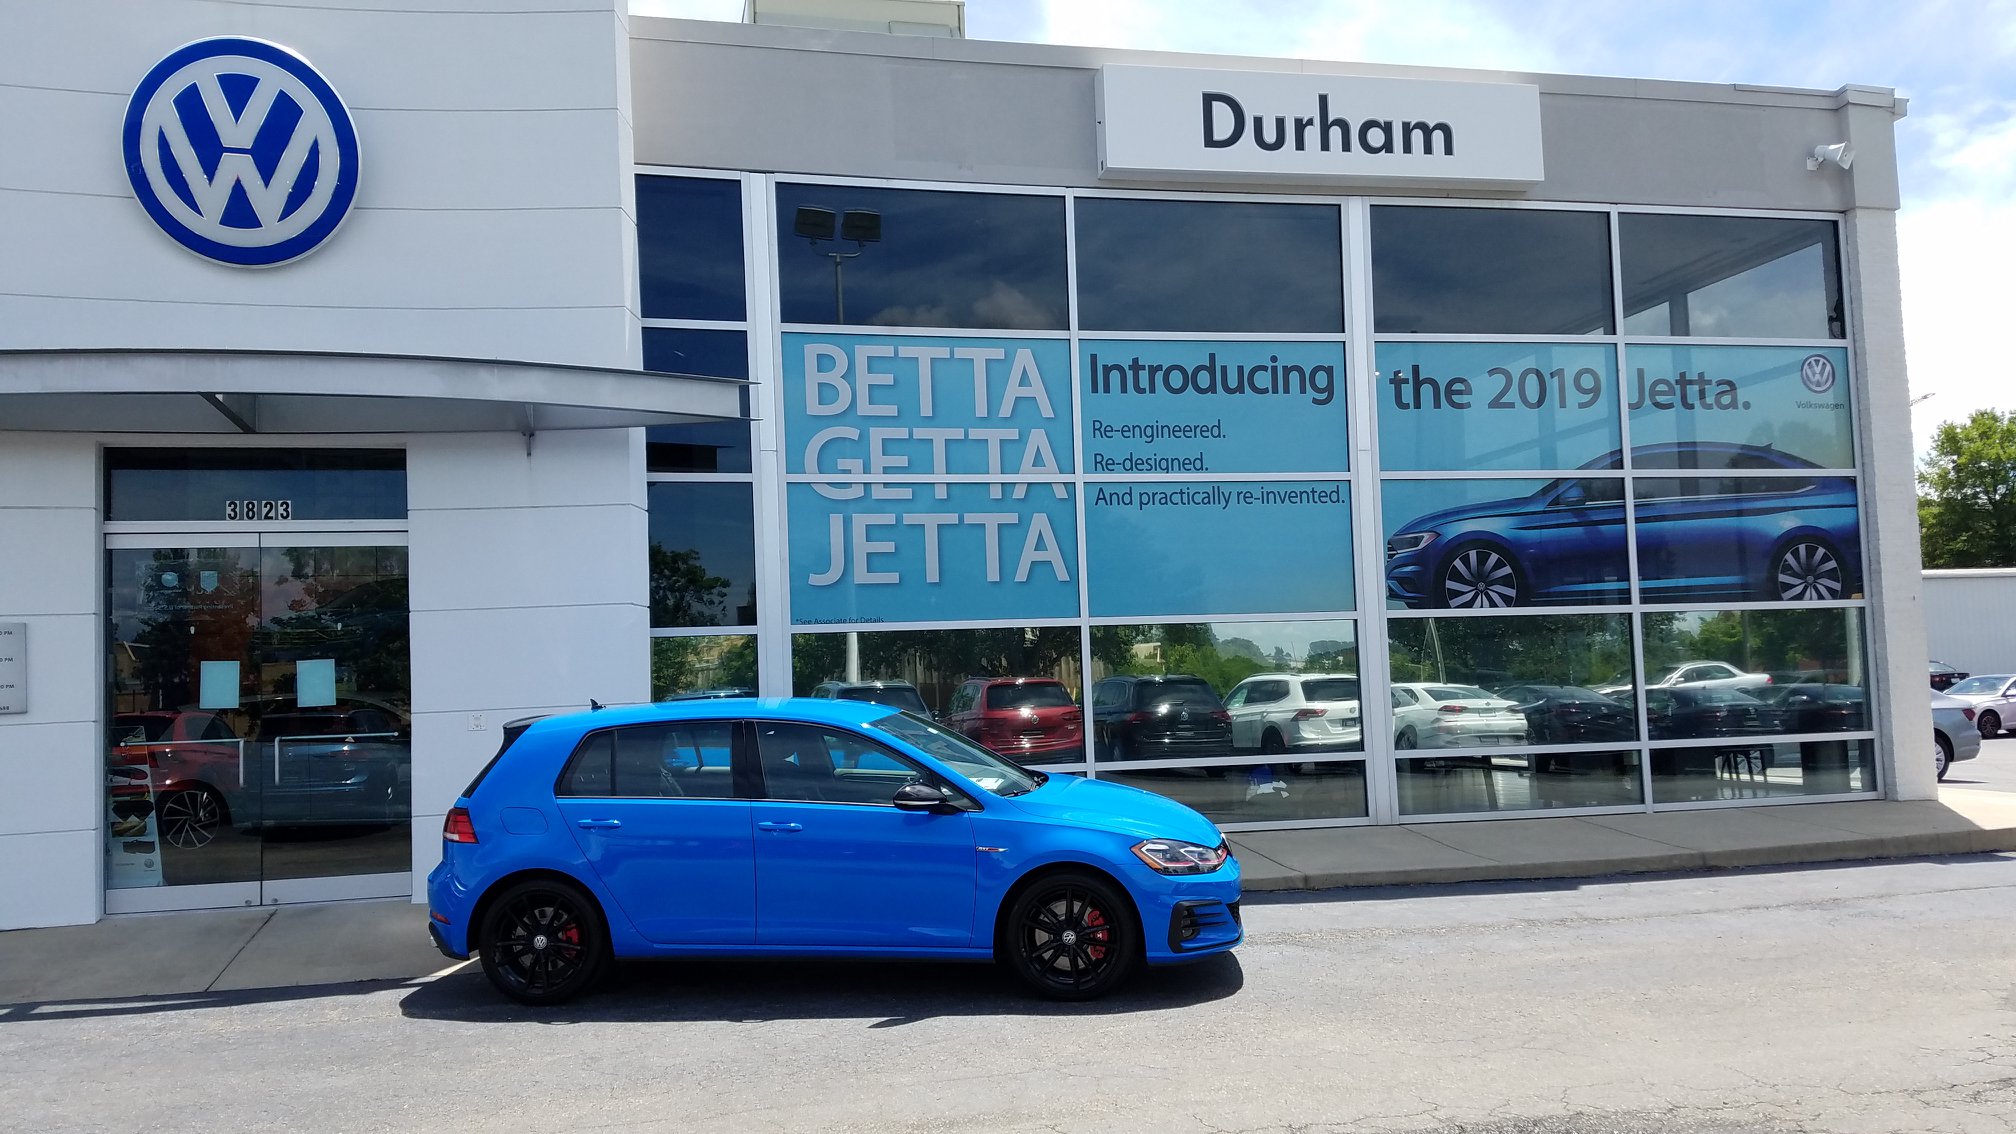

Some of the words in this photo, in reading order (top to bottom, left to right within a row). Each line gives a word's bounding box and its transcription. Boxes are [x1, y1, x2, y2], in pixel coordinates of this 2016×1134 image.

[1201, 91, 1455, 156] Durham
[803, 343, 1055, 418] BETTA
[1089, 352, 1335, 406] Introducing
[1389, 364, 1473, 410] the
[1486, 367, 1602, 410] 2019
[1628, 366, 1752, 411] Jetta.
[1795, 401, 1845, 411] Volkswagen
[1091, 418, 1227, 444] Re-engineered.
[803, 425, 1069, 500] GETTA
[1093, 451, 1209, 474] Re-designed.
[227, 500, 290, 520] 3823
[1094, 486, 1134, 507] And
[1138, 485, 1232, 511] practically
[1236, 484, 1346, 505] re-invented.
[807, 512, 1071, 586] JETTA
